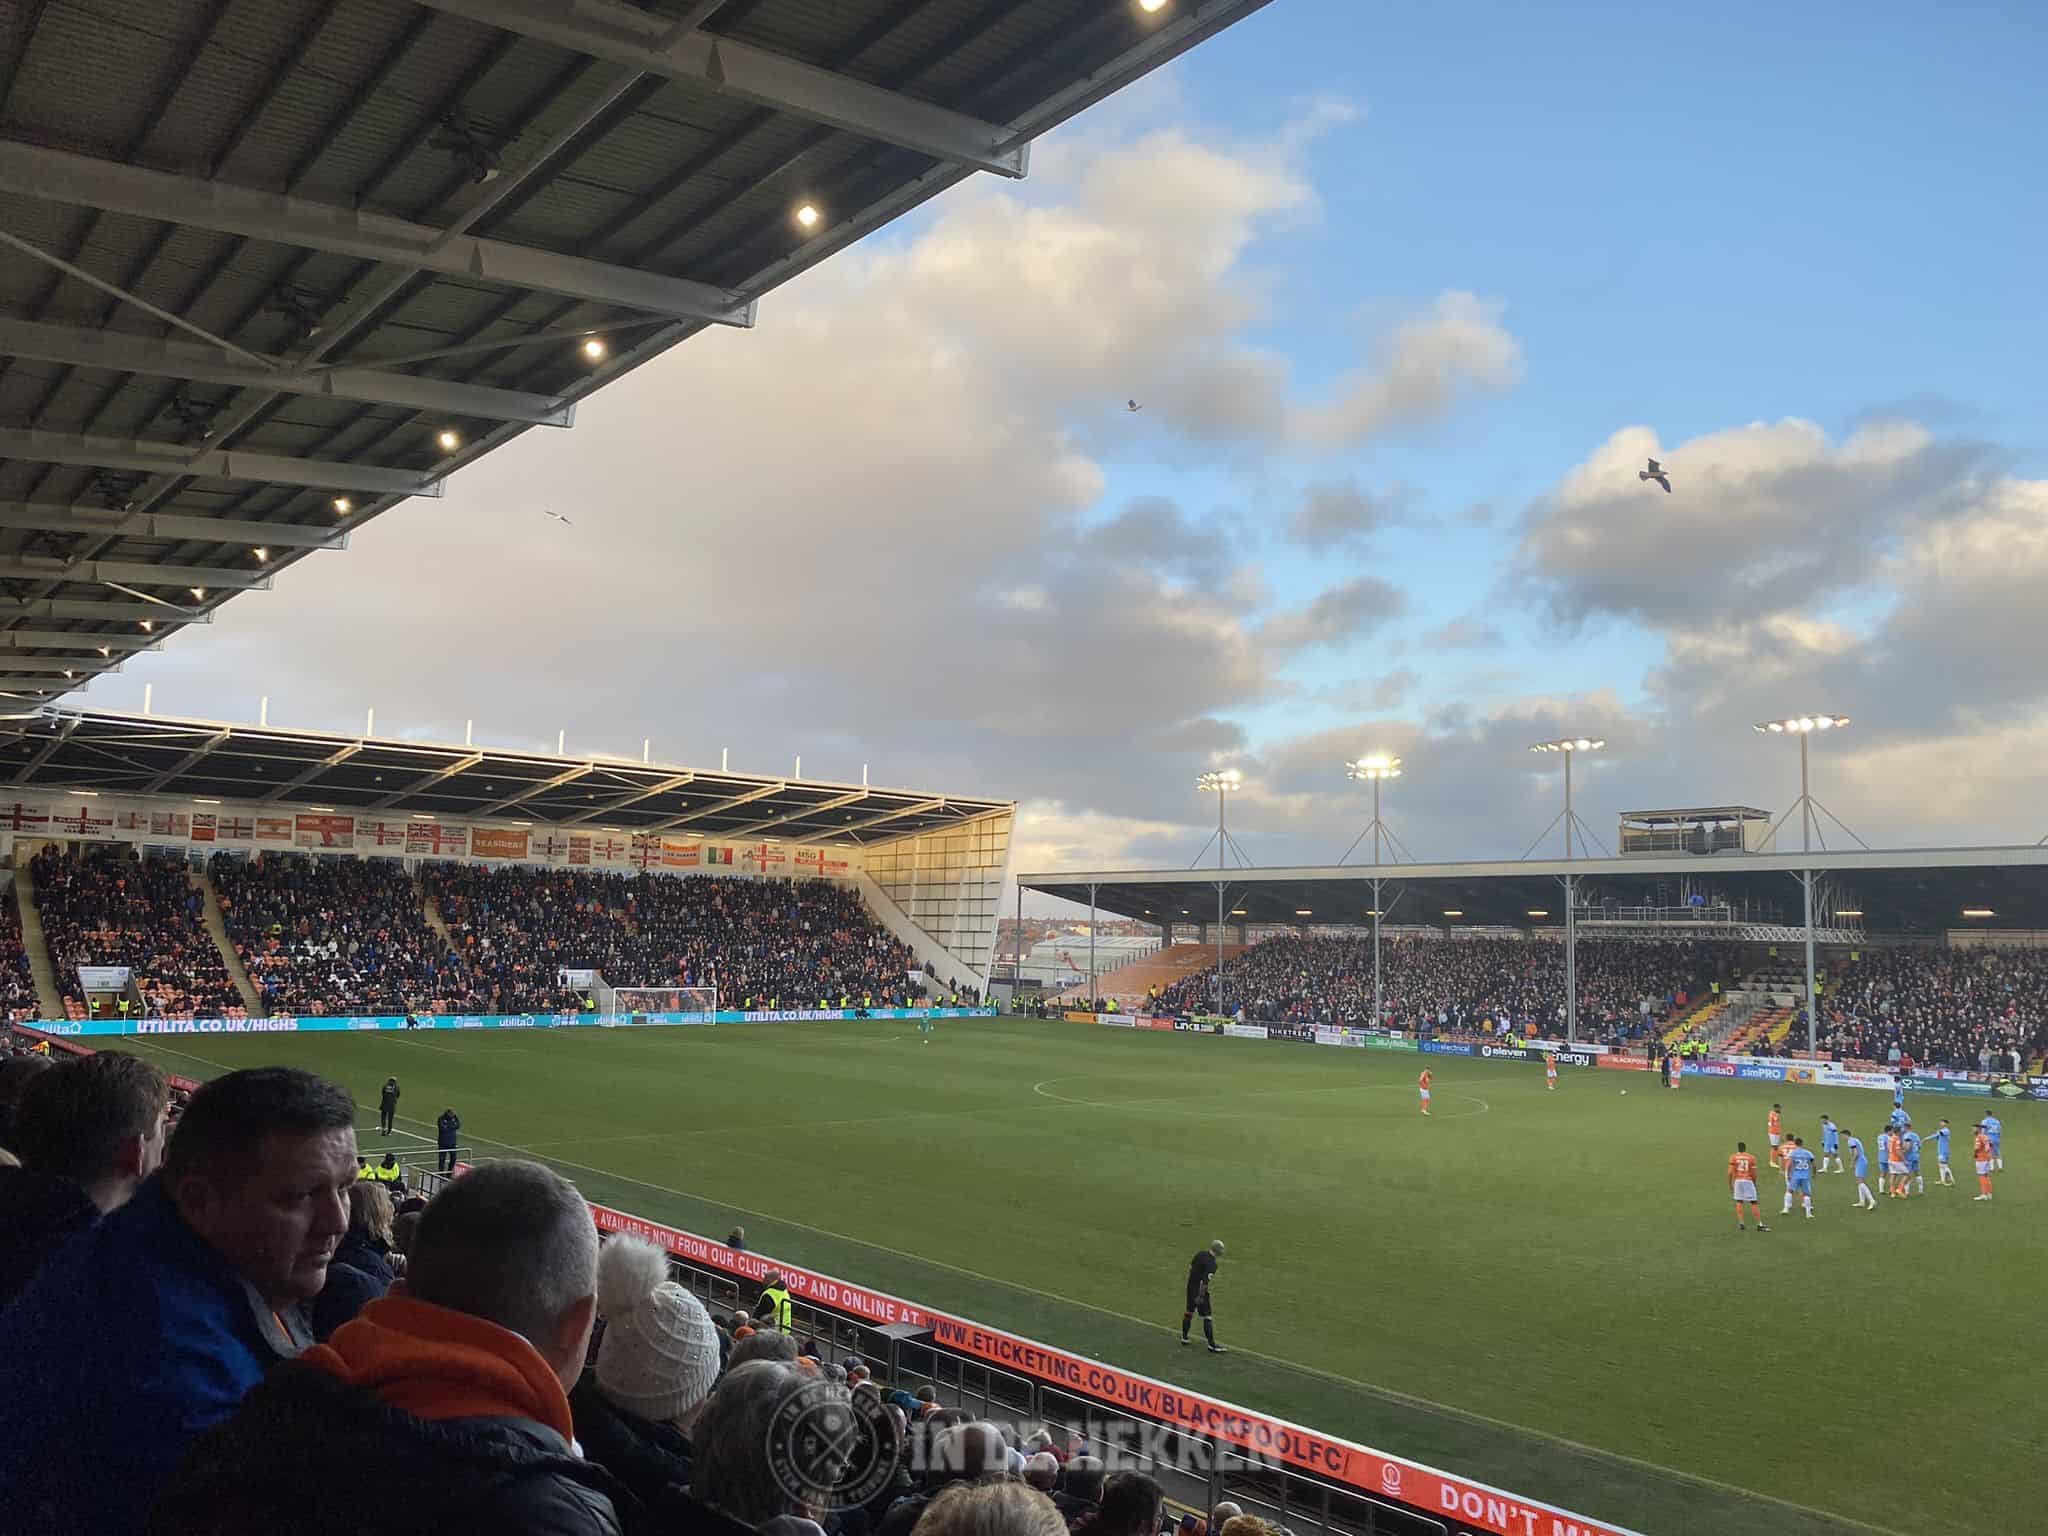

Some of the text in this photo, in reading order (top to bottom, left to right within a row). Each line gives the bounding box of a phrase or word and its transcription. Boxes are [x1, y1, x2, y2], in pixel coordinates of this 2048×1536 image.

[600, 1212, 650, 1235] AVAILABLE
[651, 1228, 676, 1249] NOW
[678, 1238, 708, 1259] FROM
[711, 1247, 735, 1267] OUR
[738, 1256, 768, 1279] CLUB
[771, 1268, 806, 1290] HOP
[810, 1279, 838, 1302] AND
[842, 1290, 896, 1321] ONLINE
[901, 1309, 920, 1326] AT
[1440, 1484, 1538, 1536] DON'T
